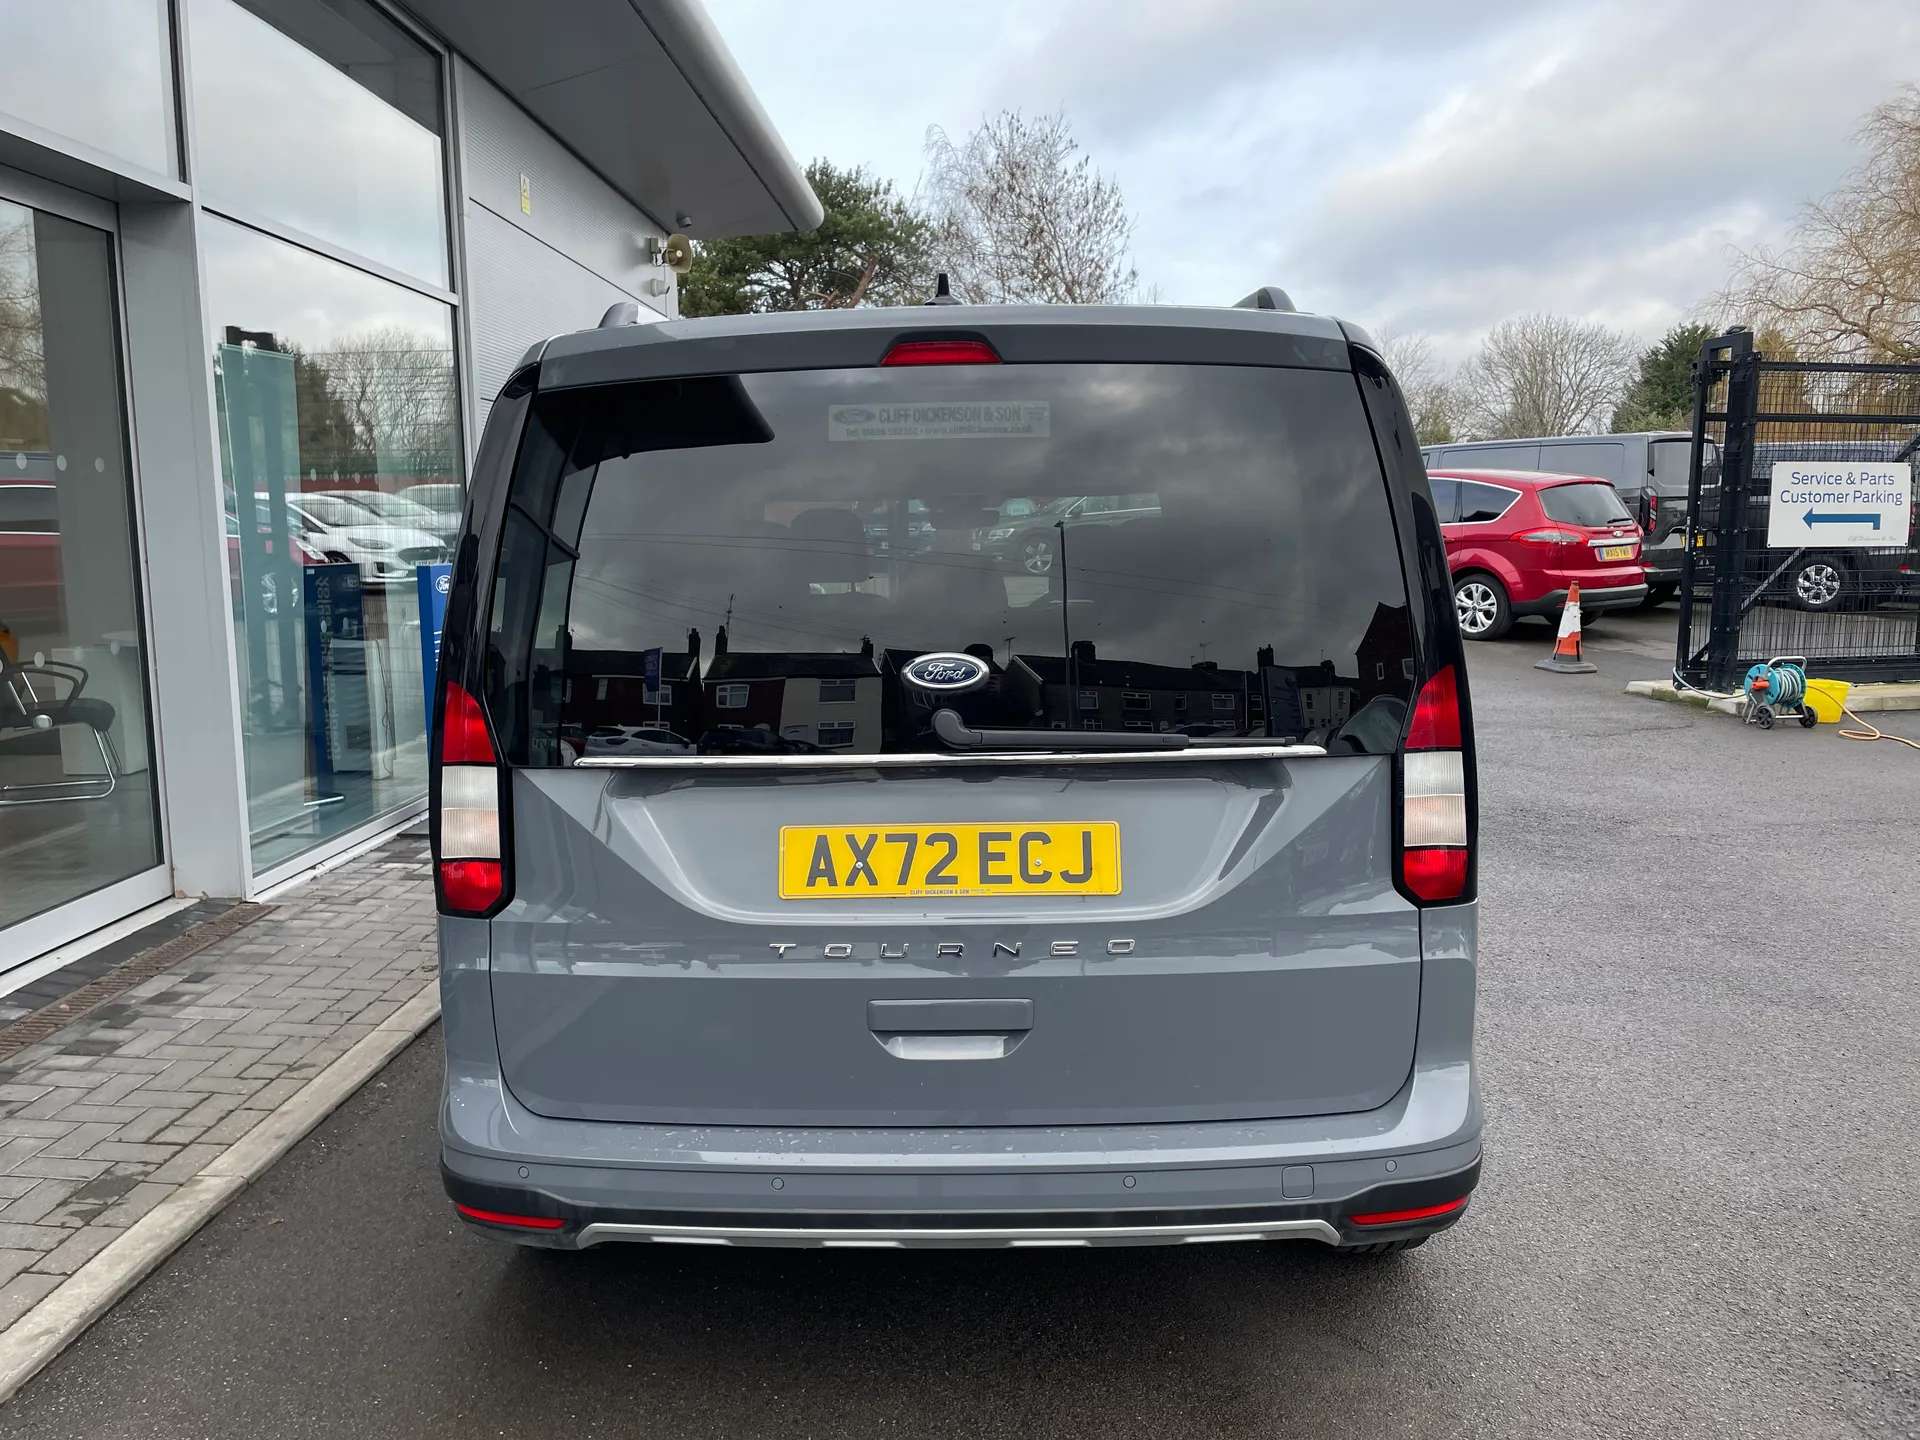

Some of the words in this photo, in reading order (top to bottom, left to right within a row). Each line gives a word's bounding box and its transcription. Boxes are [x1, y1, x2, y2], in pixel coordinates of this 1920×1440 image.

[879, 408, 910, 424] CLIFF
[995, 406, 1022, 421] SON
[1791, 472, 1843, 485] Service
[1846, 472, 1856, 485] &
[1860, 472, 1895, 485] Parts
[1780, 490, 1850, 503] Customer
[1853, 490, 1903, 506] Parking
[924, 662, 966, 681] Ford
[806, 832, 959, 888] AX72
[978, 831, 1093, 885] ECJ
[769, 938, 1136, 959] TOURNEO
